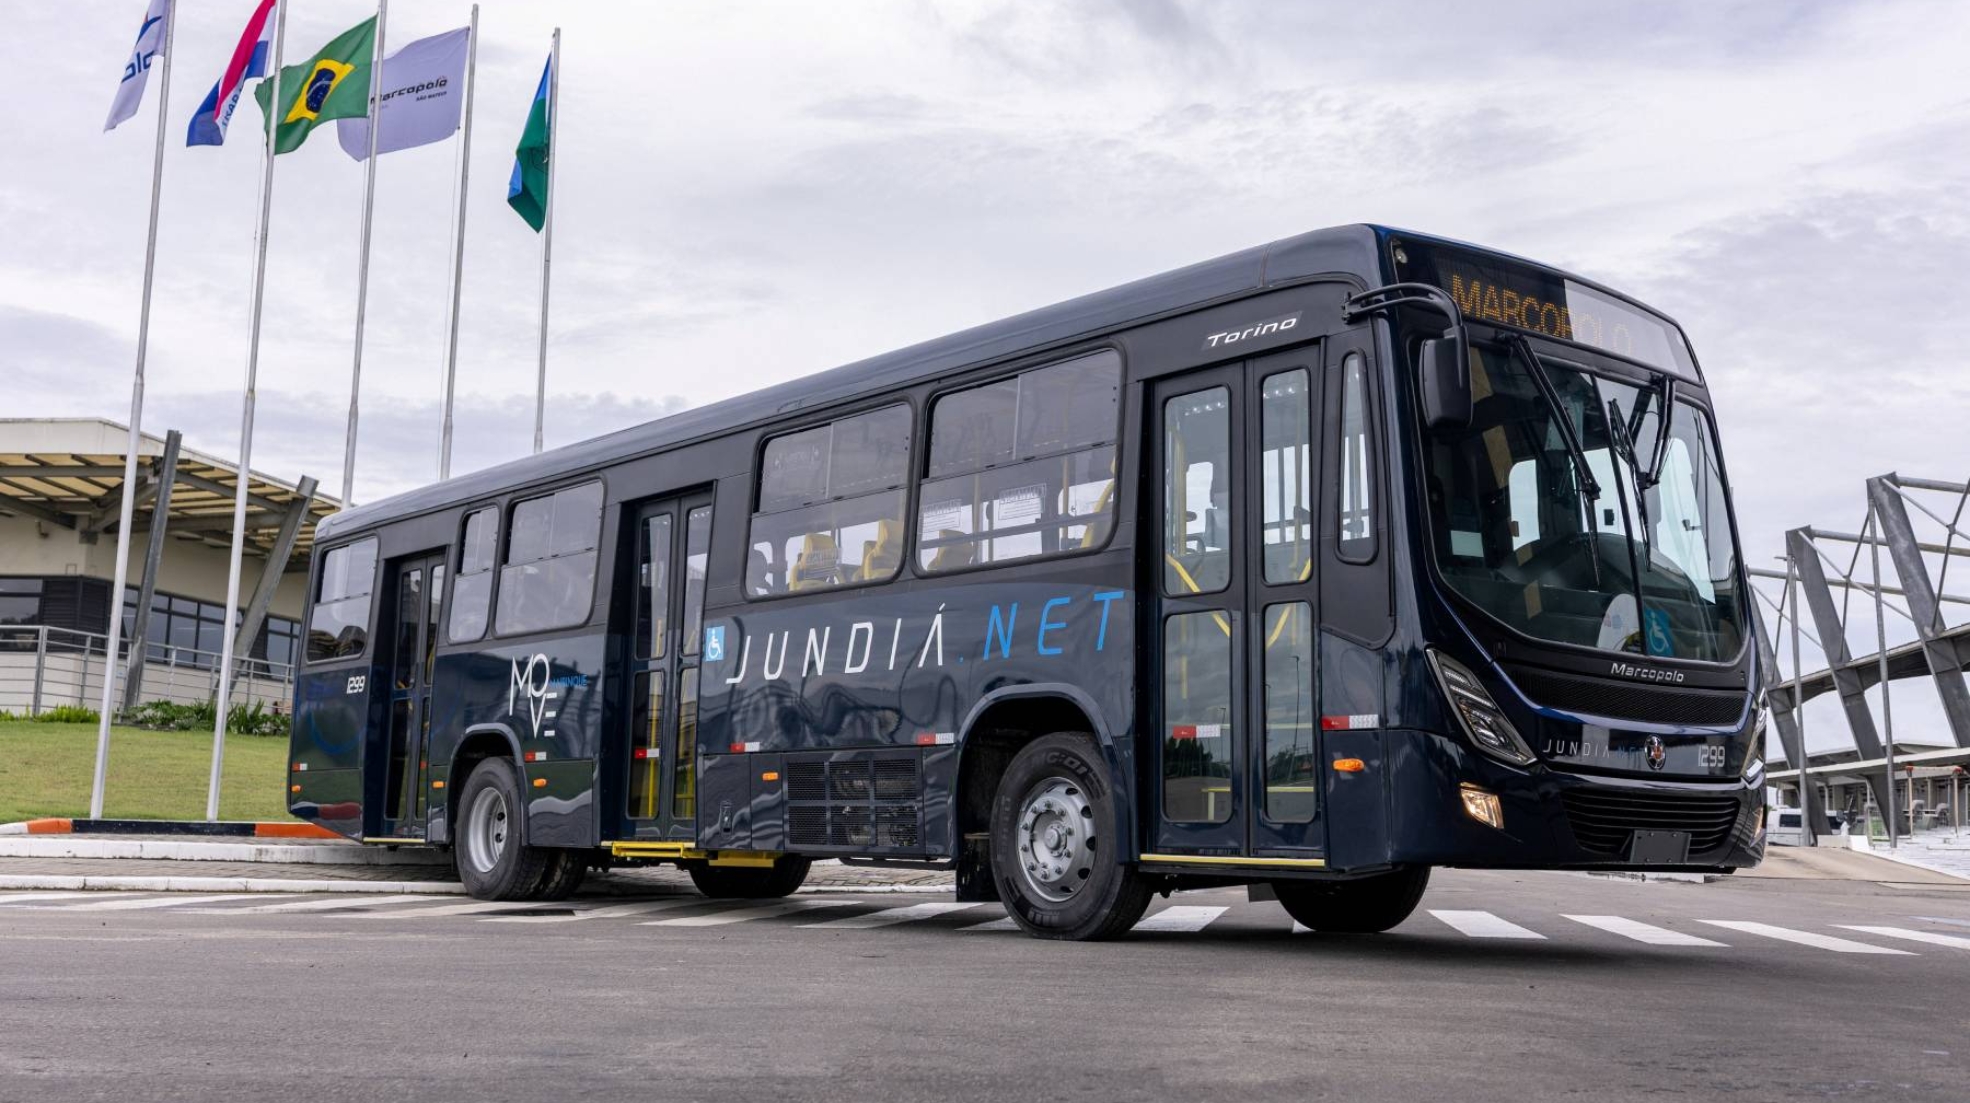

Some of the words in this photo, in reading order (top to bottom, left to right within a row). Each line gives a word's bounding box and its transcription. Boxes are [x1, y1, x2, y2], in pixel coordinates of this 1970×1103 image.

[1207, 317, 1297, 347] Torino
[1611, 662, 1684, 683] Marcopolo
[346, 675, 366, 694] 1299
[1698, 745, 1726, 767] 1299
